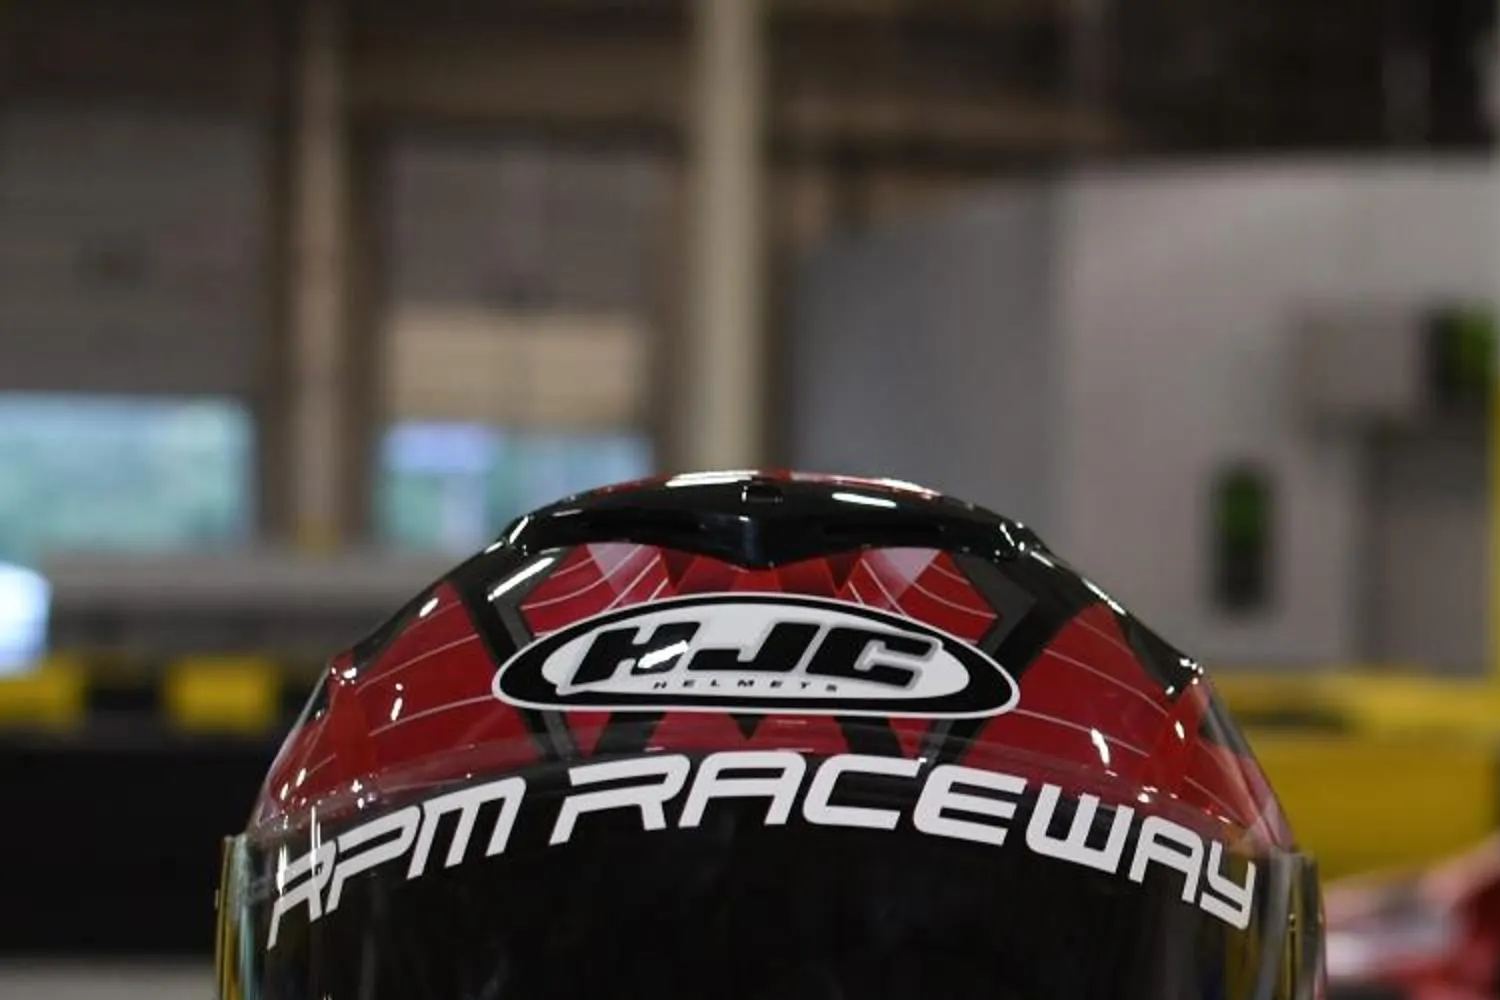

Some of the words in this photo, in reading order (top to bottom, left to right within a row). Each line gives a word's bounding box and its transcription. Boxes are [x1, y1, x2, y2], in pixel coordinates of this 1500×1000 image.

[570, 620, 940, 689] HJC
[652, 679, 839, 693] HELMETS
[266, 775, 527, 951] RPM
[548, 750, 1257, 930] RACEWAY
